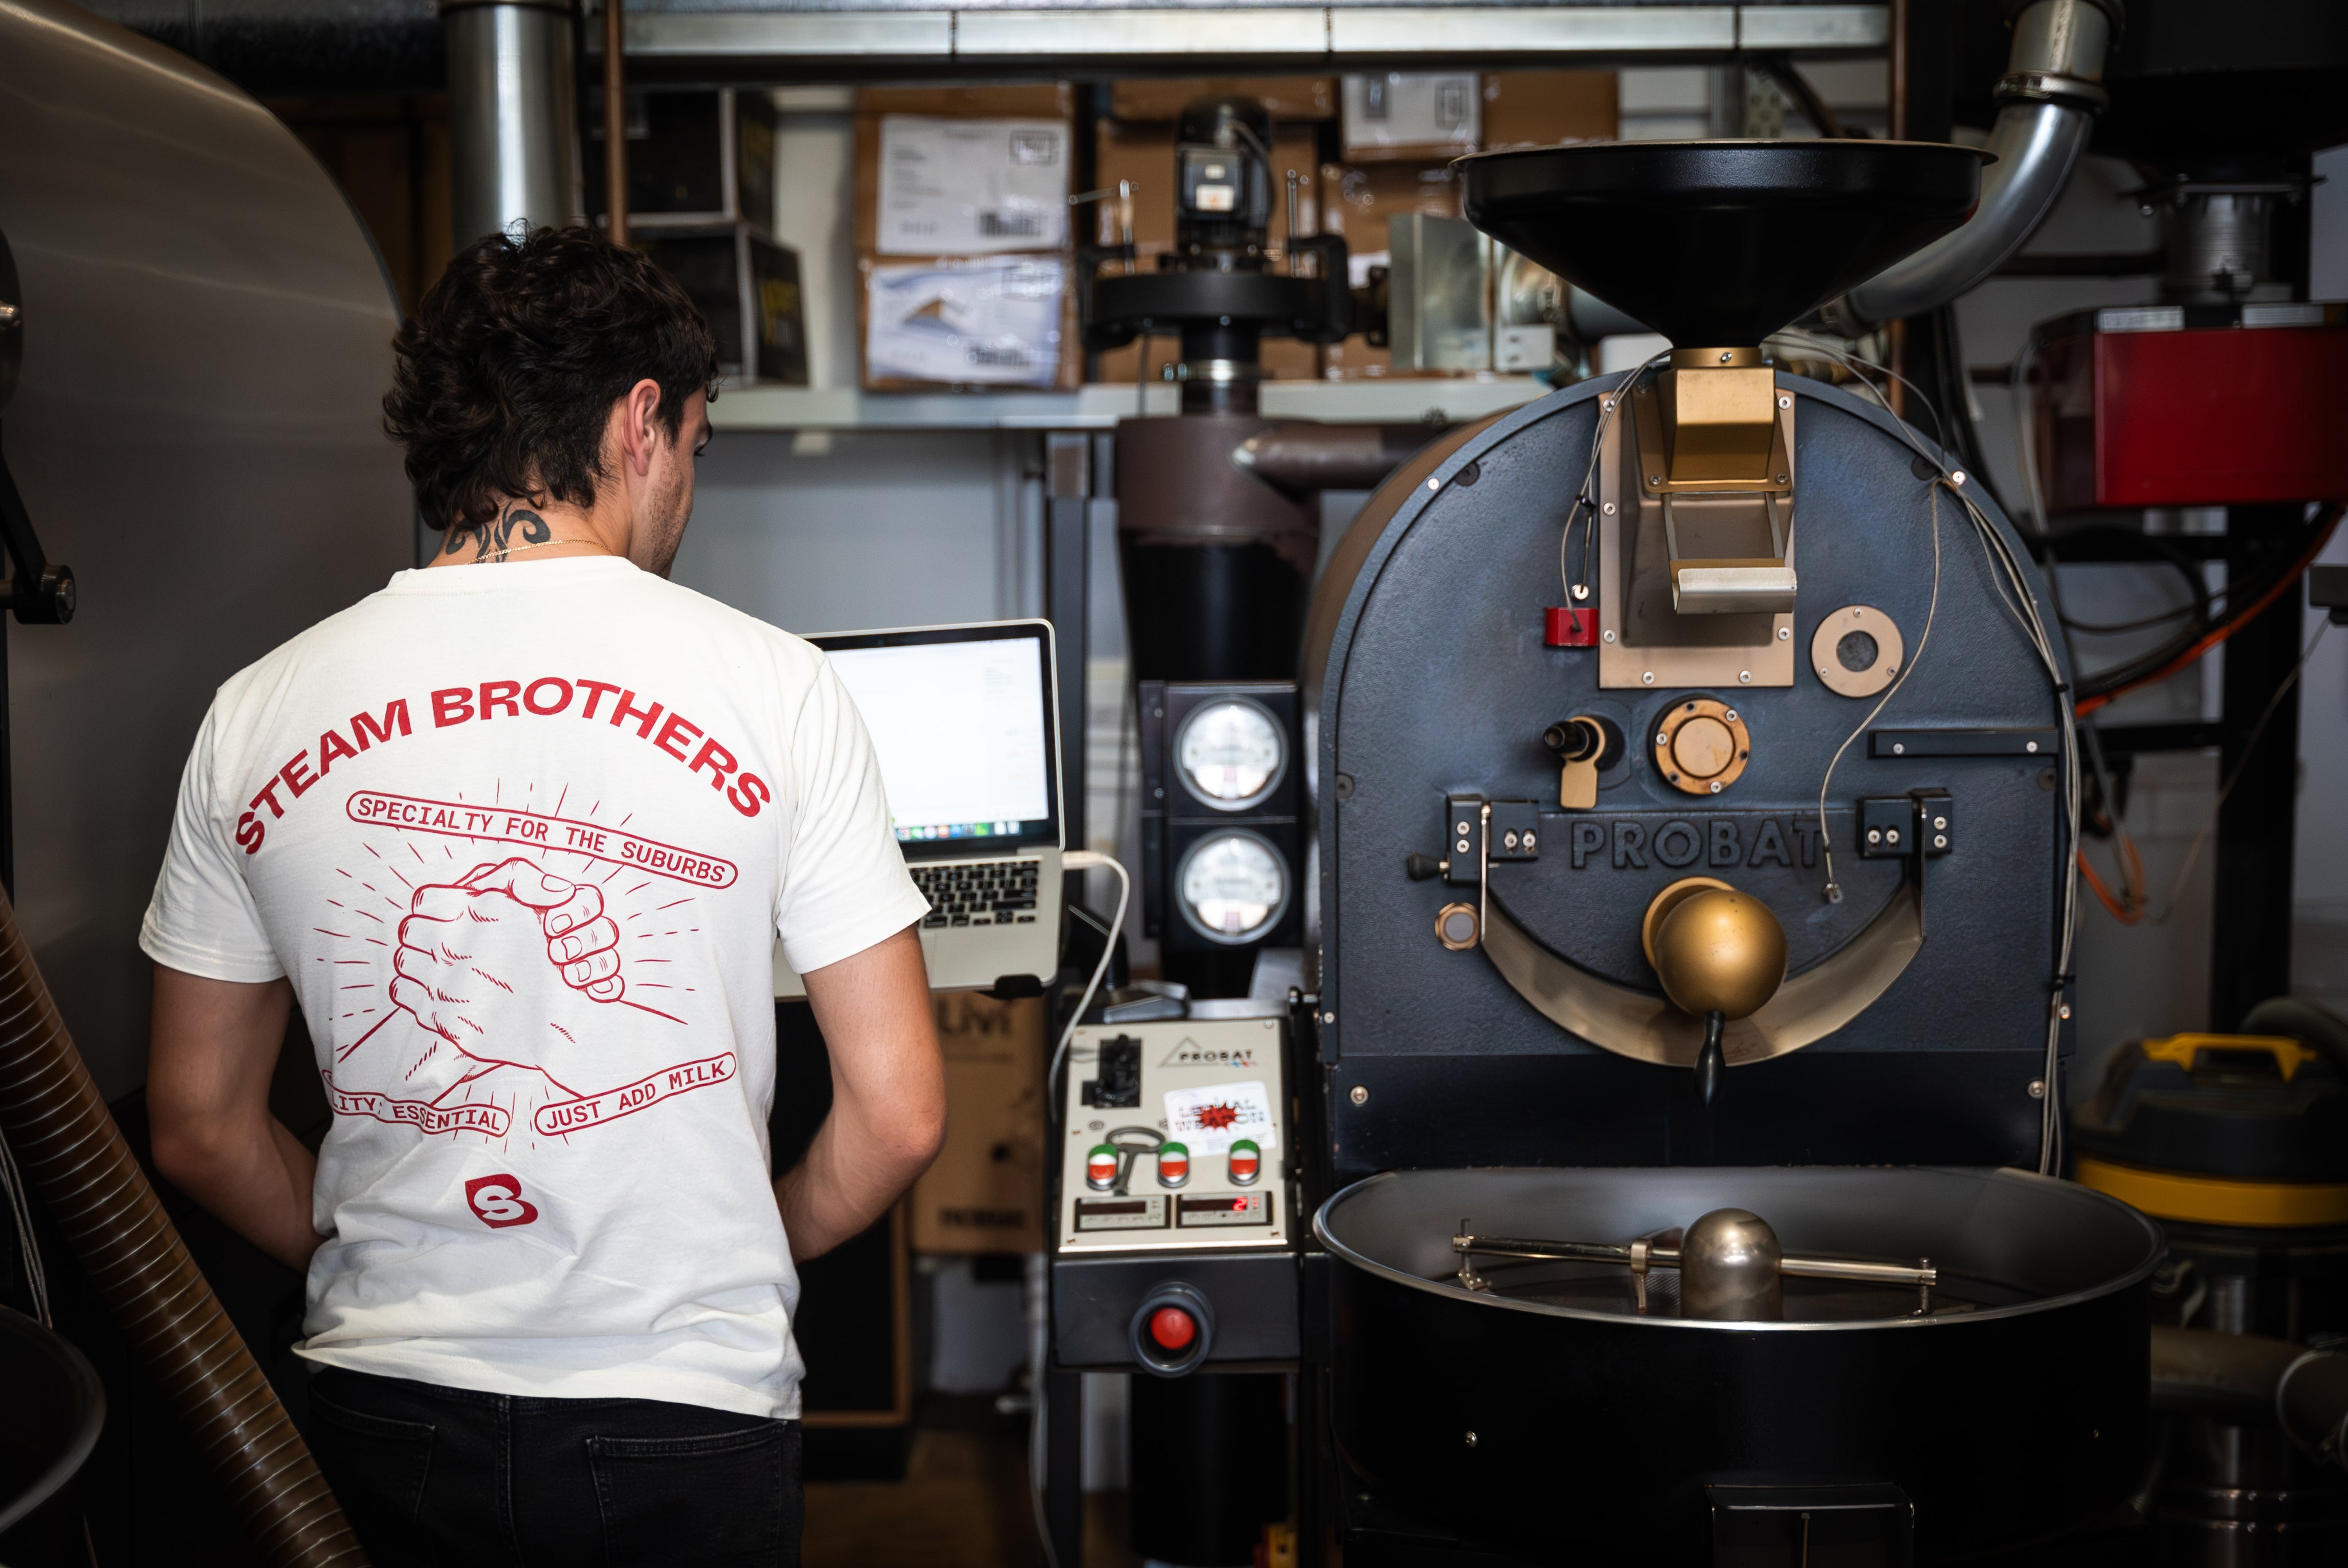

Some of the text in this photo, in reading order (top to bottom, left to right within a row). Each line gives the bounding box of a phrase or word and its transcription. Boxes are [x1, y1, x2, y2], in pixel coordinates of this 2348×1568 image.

[235, 676, 770, 854] STEAM BROTHERS
[357, 797, 726, 883] SPECIALTY FOR THE SUBURBS
[1570, 818, 1823, 870] PROBAT
[1179, 1049, 1252, 1062] PROBAT
[392, 1105, 500, 1131] ESSENTIAL
[546, 1060, 726, 1129] JUST ADD MILK
